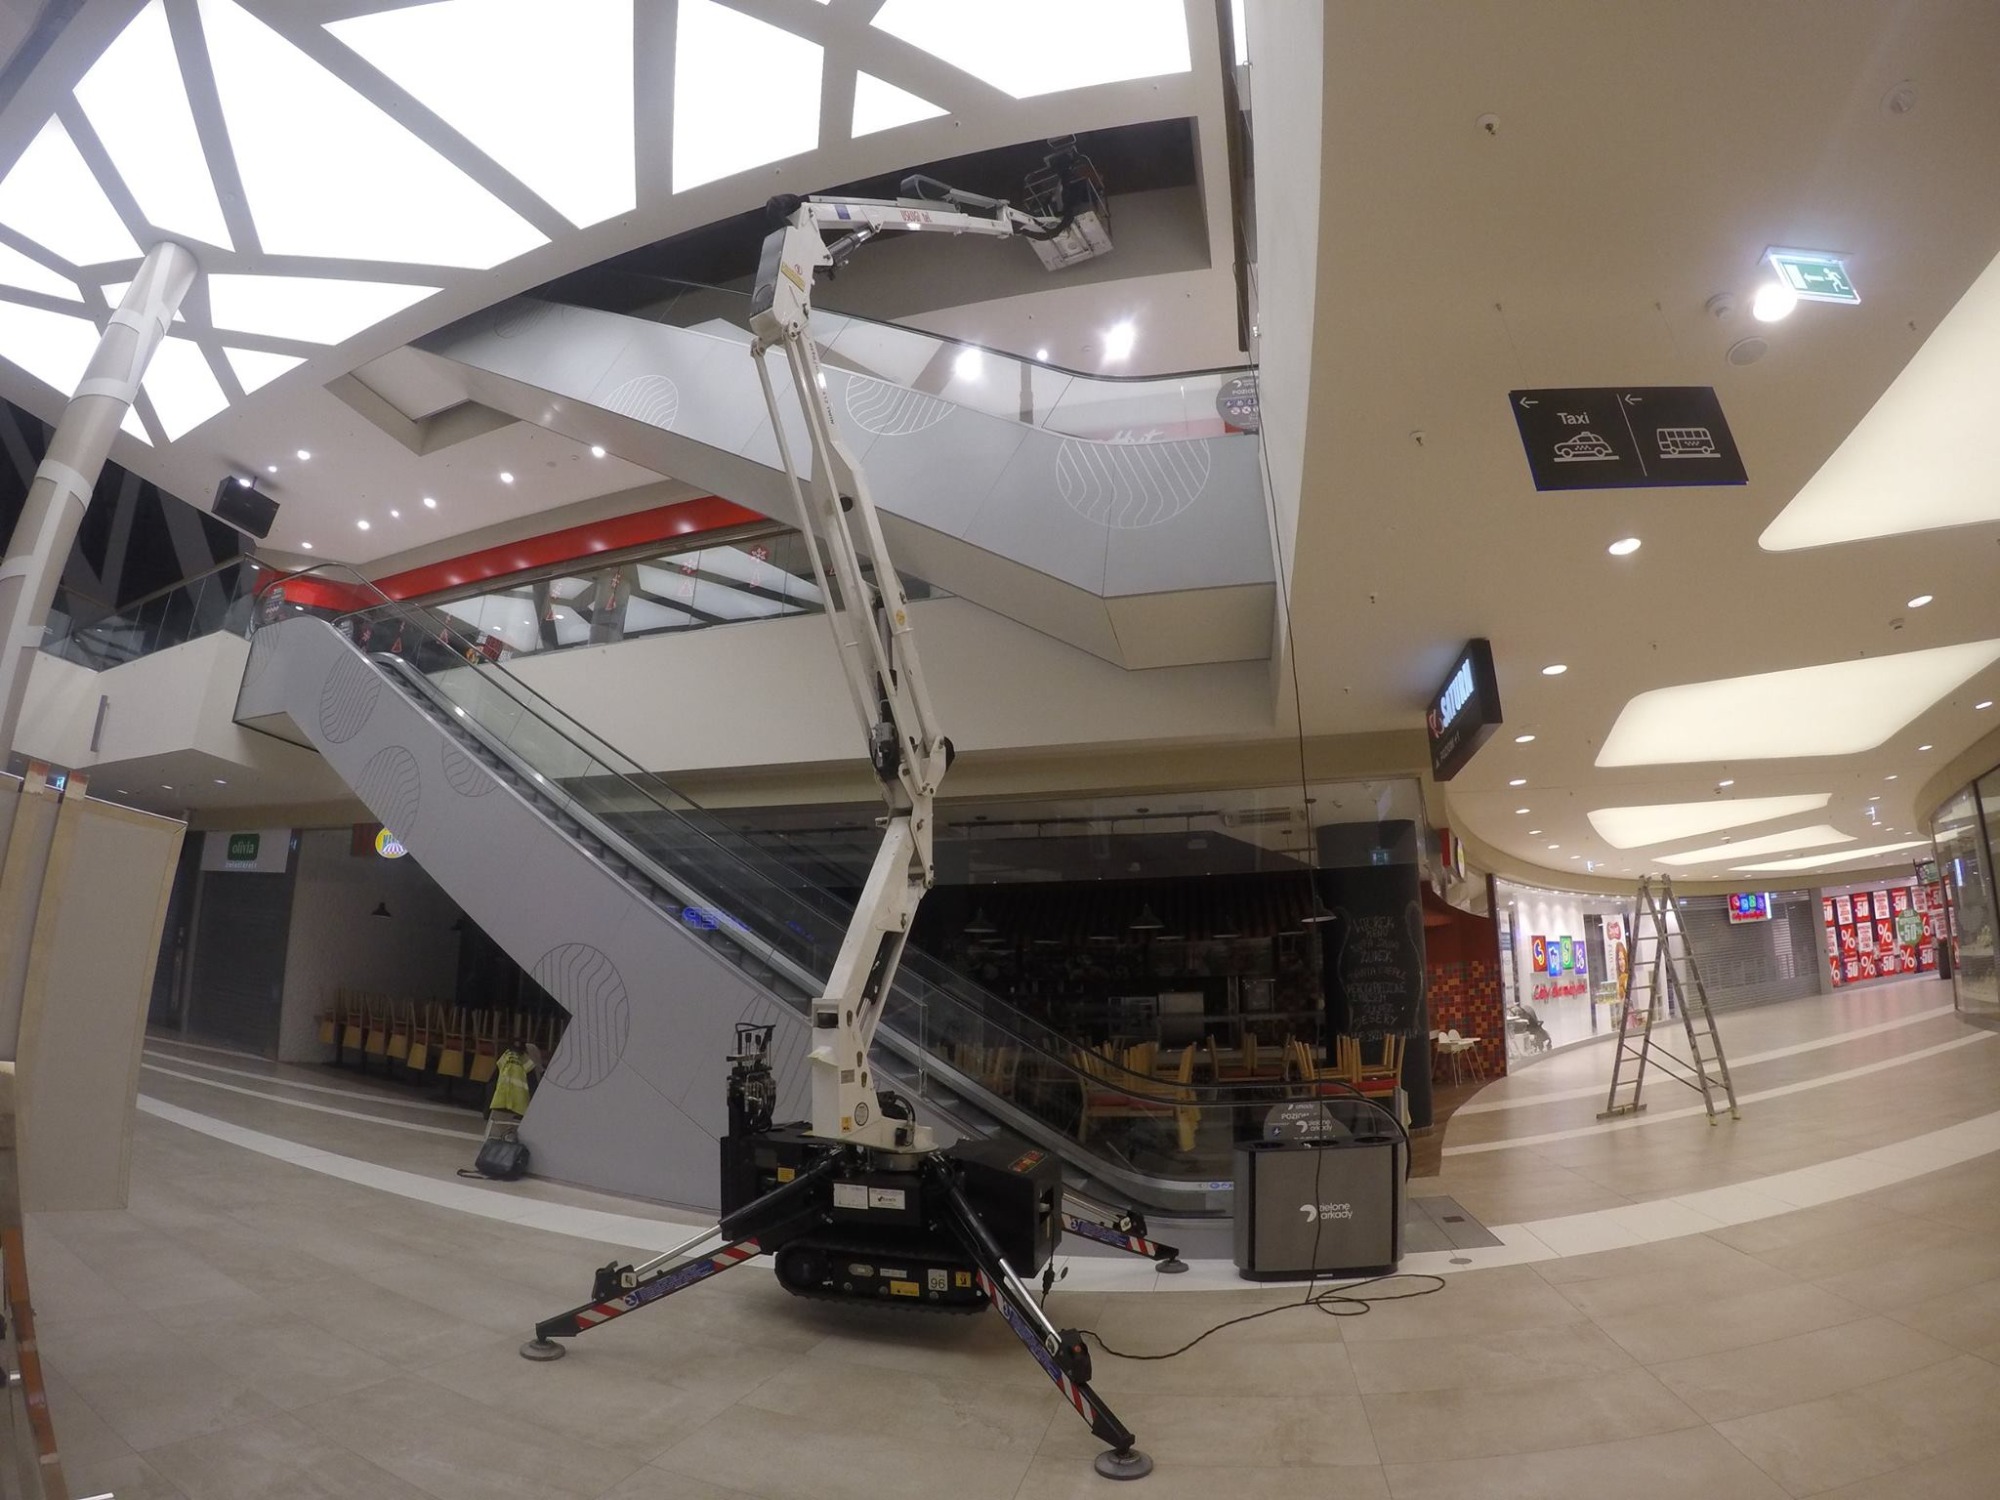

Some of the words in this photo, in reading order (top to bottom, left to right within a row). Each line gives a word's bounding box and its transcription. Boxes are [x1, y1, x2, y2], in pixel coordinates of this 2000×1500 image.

[1556, 411, 1590, 425] Taxi
[1440, 658, 1474, 728] SATURN
[1321, 1210, 1353, 1219] arkady
[930, 1277, 945, 1289] 96
